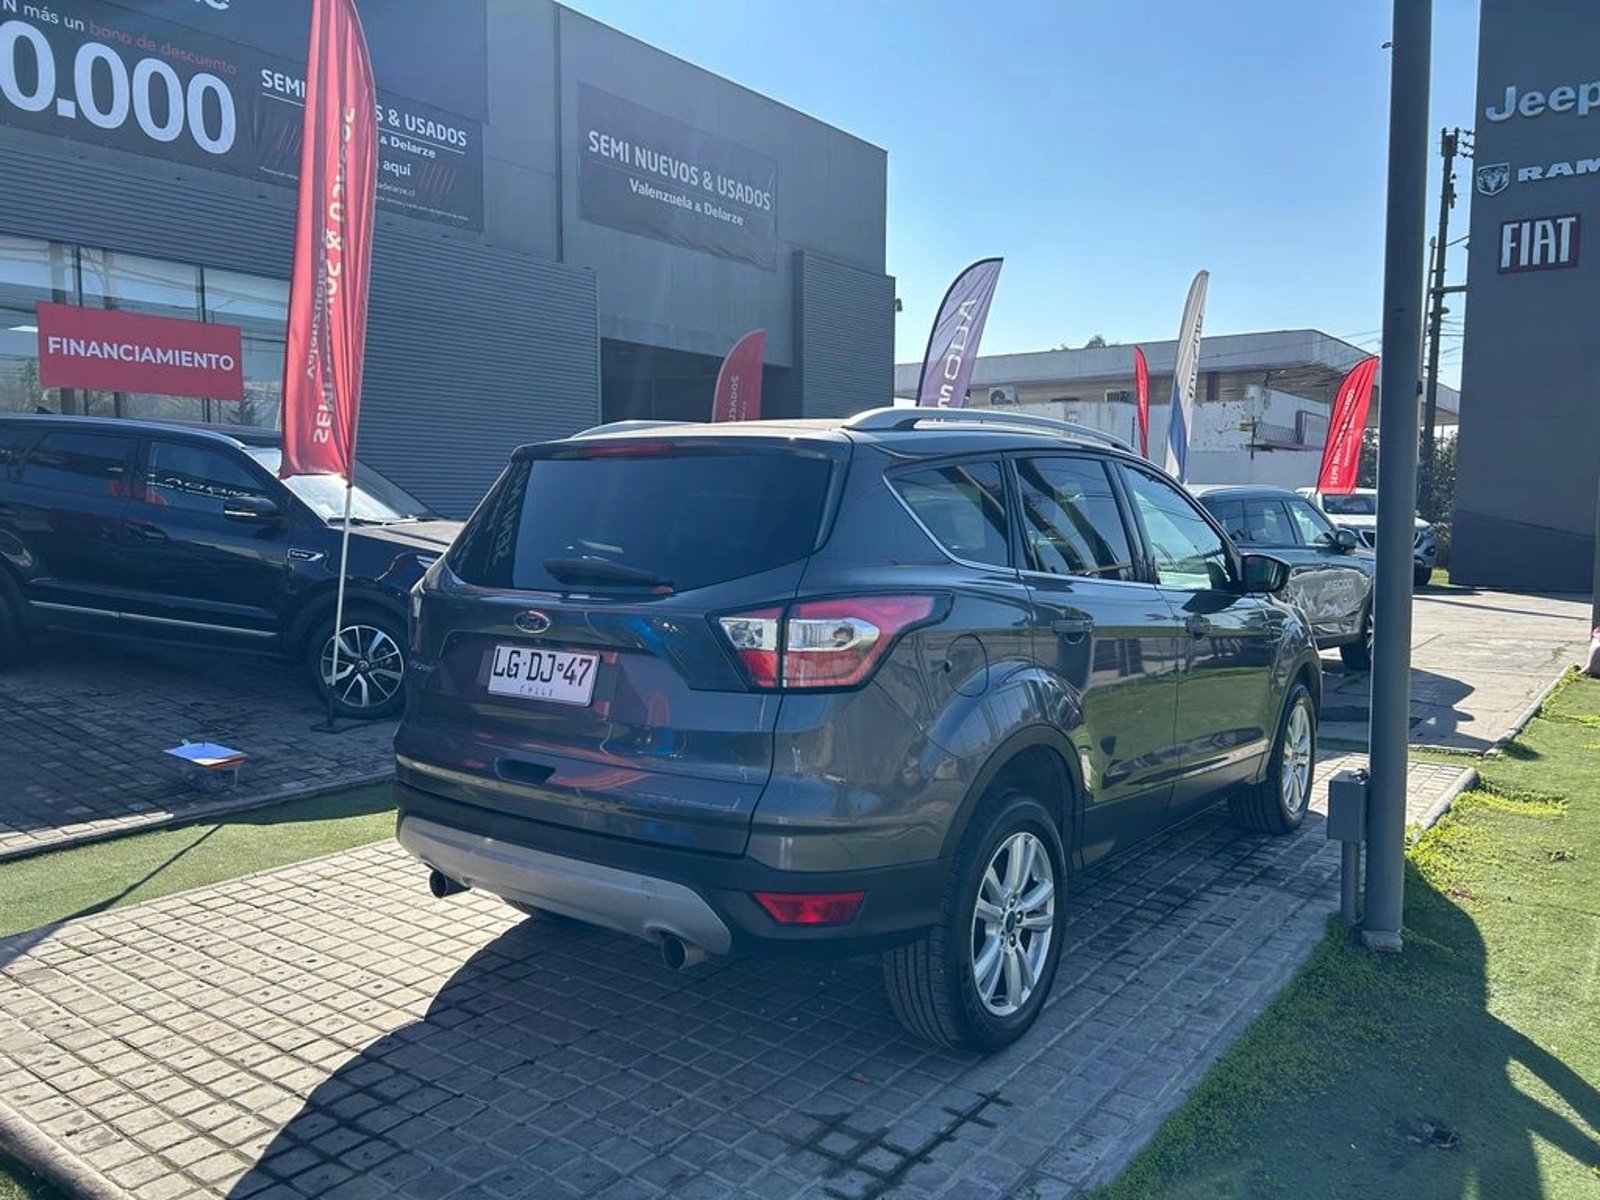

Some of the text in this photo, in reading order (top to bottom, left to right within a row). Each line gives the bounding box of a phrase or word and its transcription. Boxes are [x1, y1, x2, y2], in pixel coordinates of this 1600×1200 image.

[23, 5, 59, 25] más
[63, 16, 85, 32] un
[90, 22, 132, 45] bono
[137, 35, 156, 50] de
[161, 42, 236, 75] descuento
[1485, 81, 1600, 122] Jeep
[388, 109, 400, 127] &
[404, 113, 467, 147] USADOS
[390, 137, 436, 159] Delarze
[382, 160, 412, 177] aquí
[588, 130, 771, 211] SEMI NUEVOS & USADOS
[1518, 158, 1600, 182] RAM
[629, 178, 693, 210] Valenzuela
[704, 202, 744, 226] Delarze
[1501, 217, 1576, 268] FIAT
[48, 336, 235, 371] FINANCIAMIENTO
[937, 299, 977, 409] MODA
